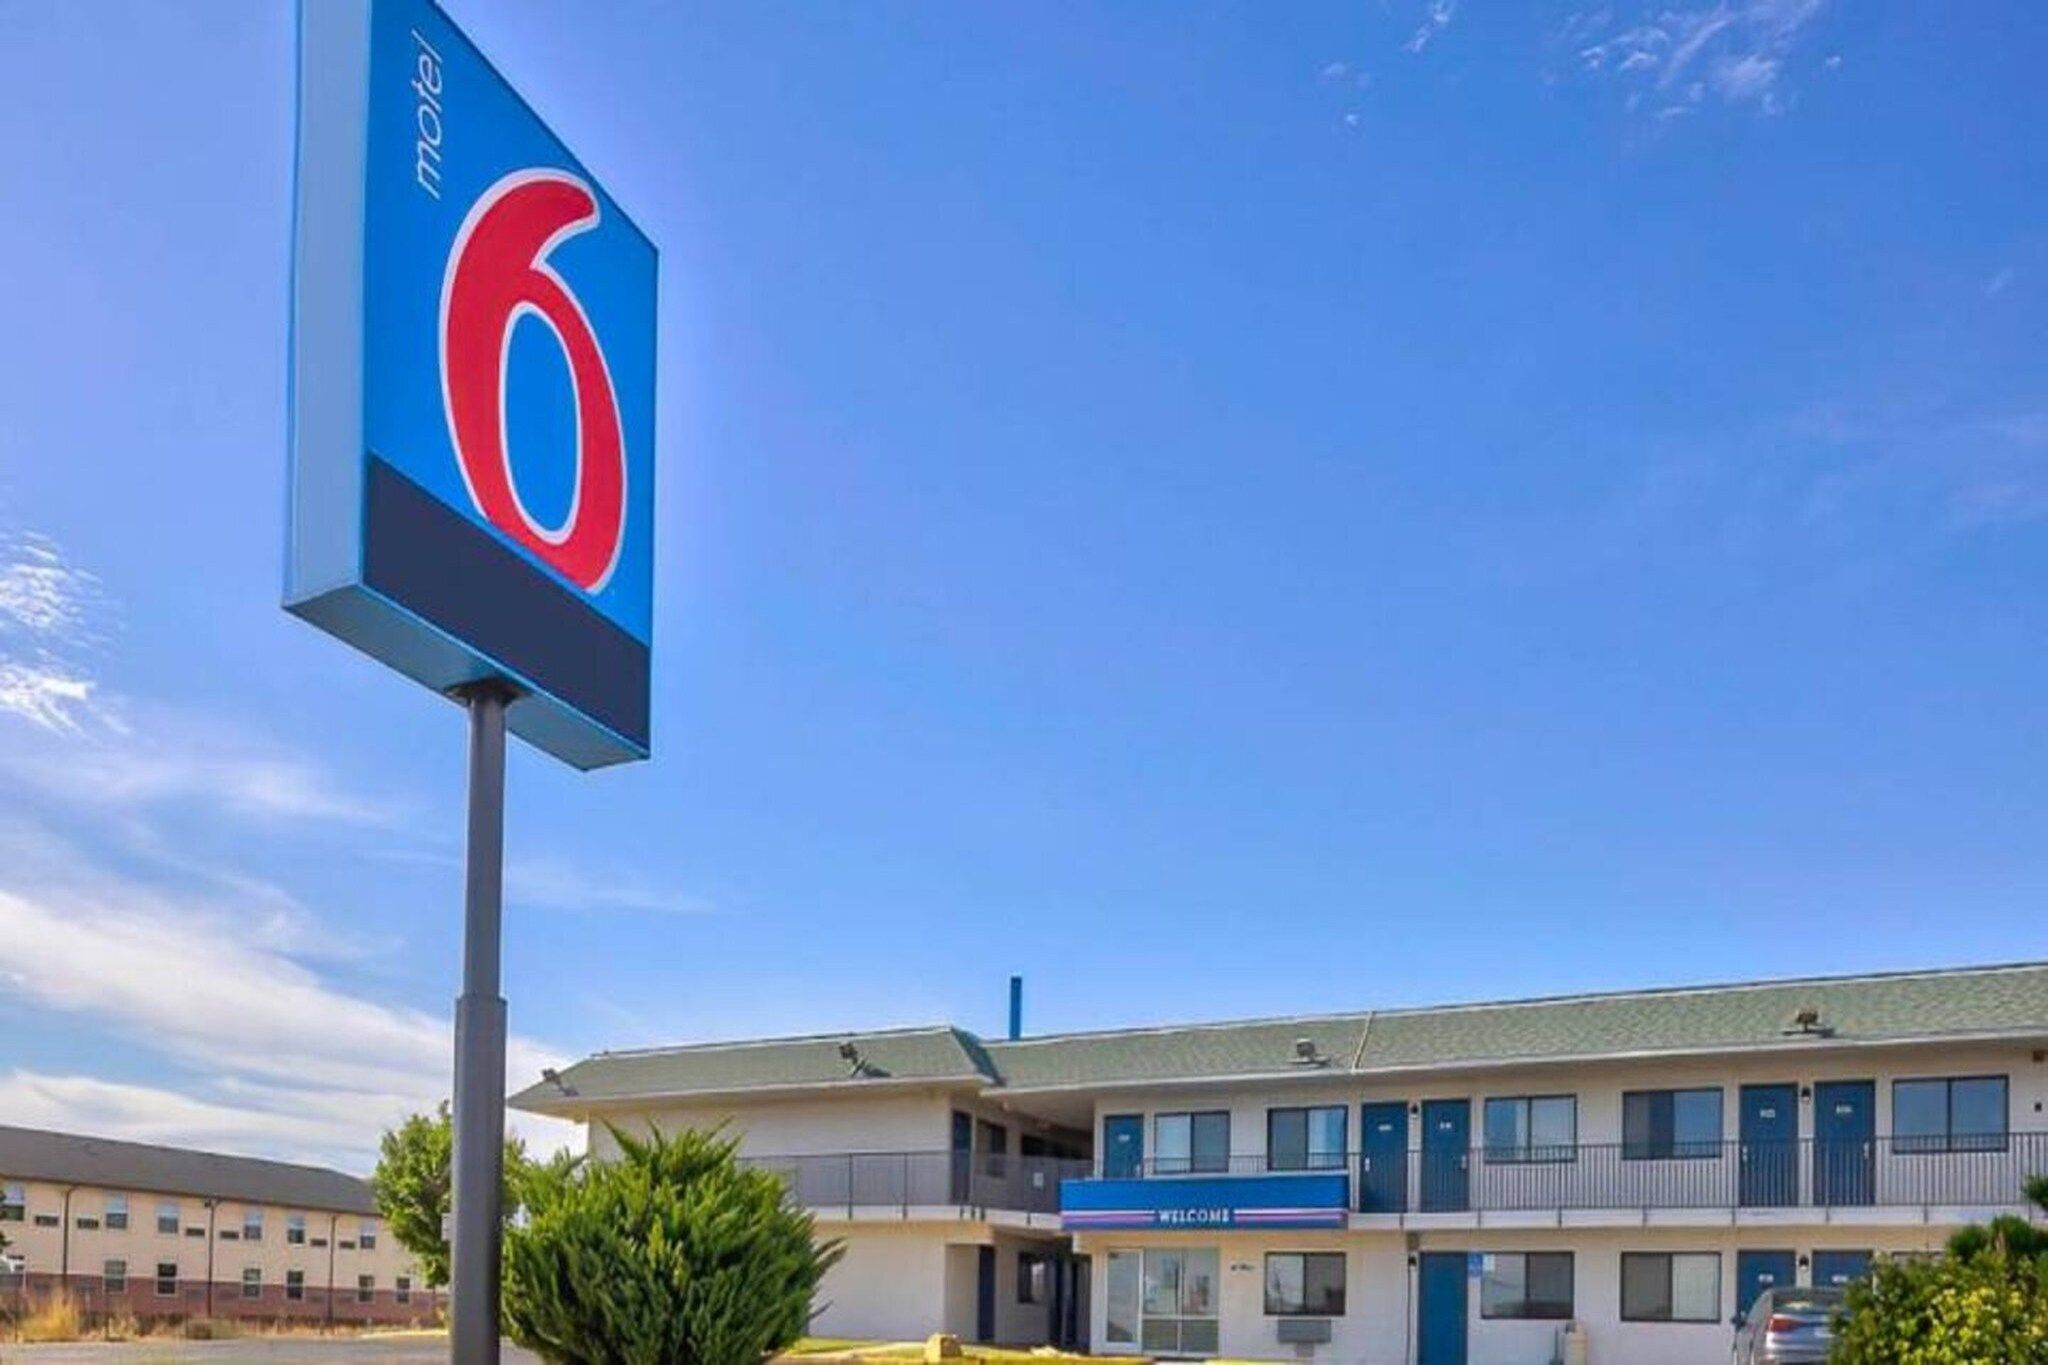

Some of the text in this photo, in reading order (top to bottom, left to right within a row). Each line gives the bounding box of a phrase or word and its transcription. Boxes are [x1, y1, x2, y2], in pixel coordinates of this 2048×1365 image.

[411, 29, 443, 200] motel
[439, 166, 628, 595] 6
[1158, 1207, 1230, 1223] WELCOME
